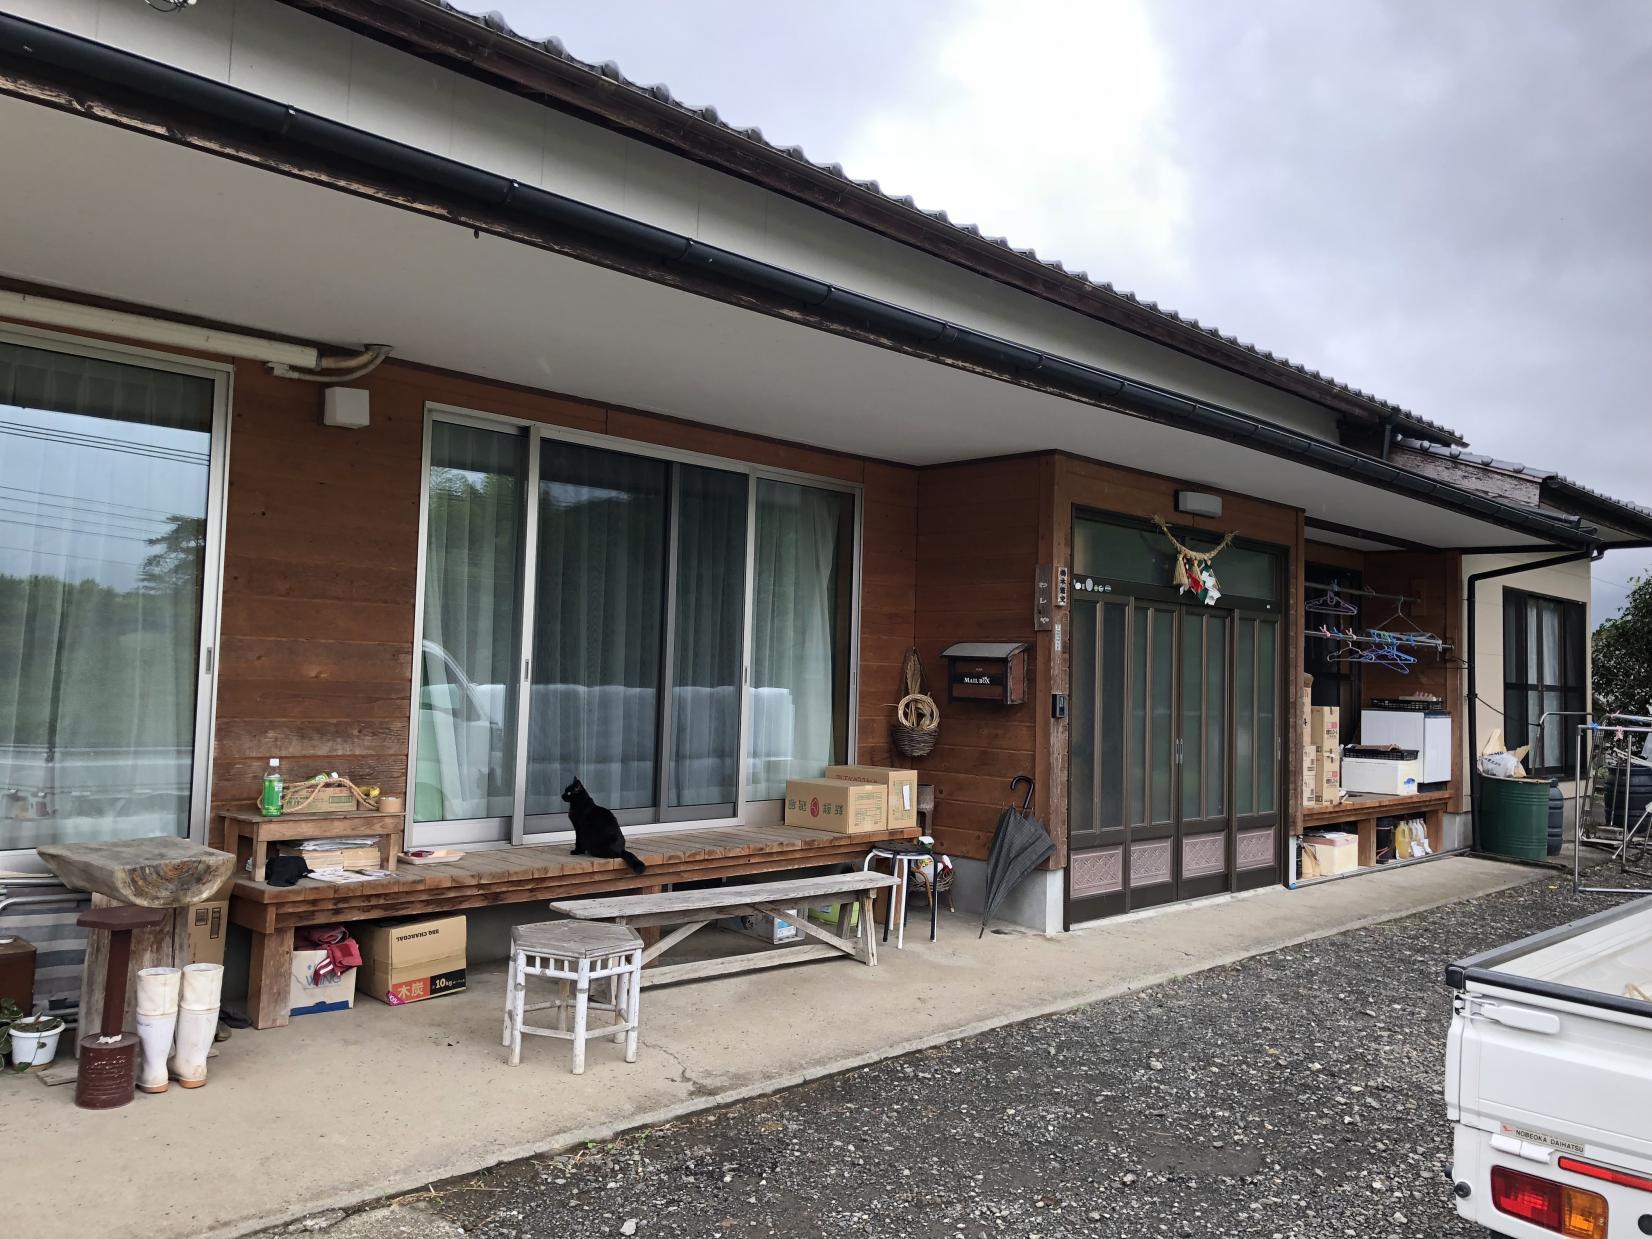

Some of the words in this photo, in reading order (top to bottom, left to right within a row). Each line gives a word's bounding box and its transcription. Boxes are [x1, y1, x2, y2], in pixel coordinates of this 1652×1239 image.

[979, 676, 990, 684] BOX
[396, 932, 428, 942] CHARCOAL
[397, 981, 424, 999] 木炭
[1515, 1129, 1548, 1143] NOBEOKA
[1550, 1138, 1584, 1153] DAIHATSU
